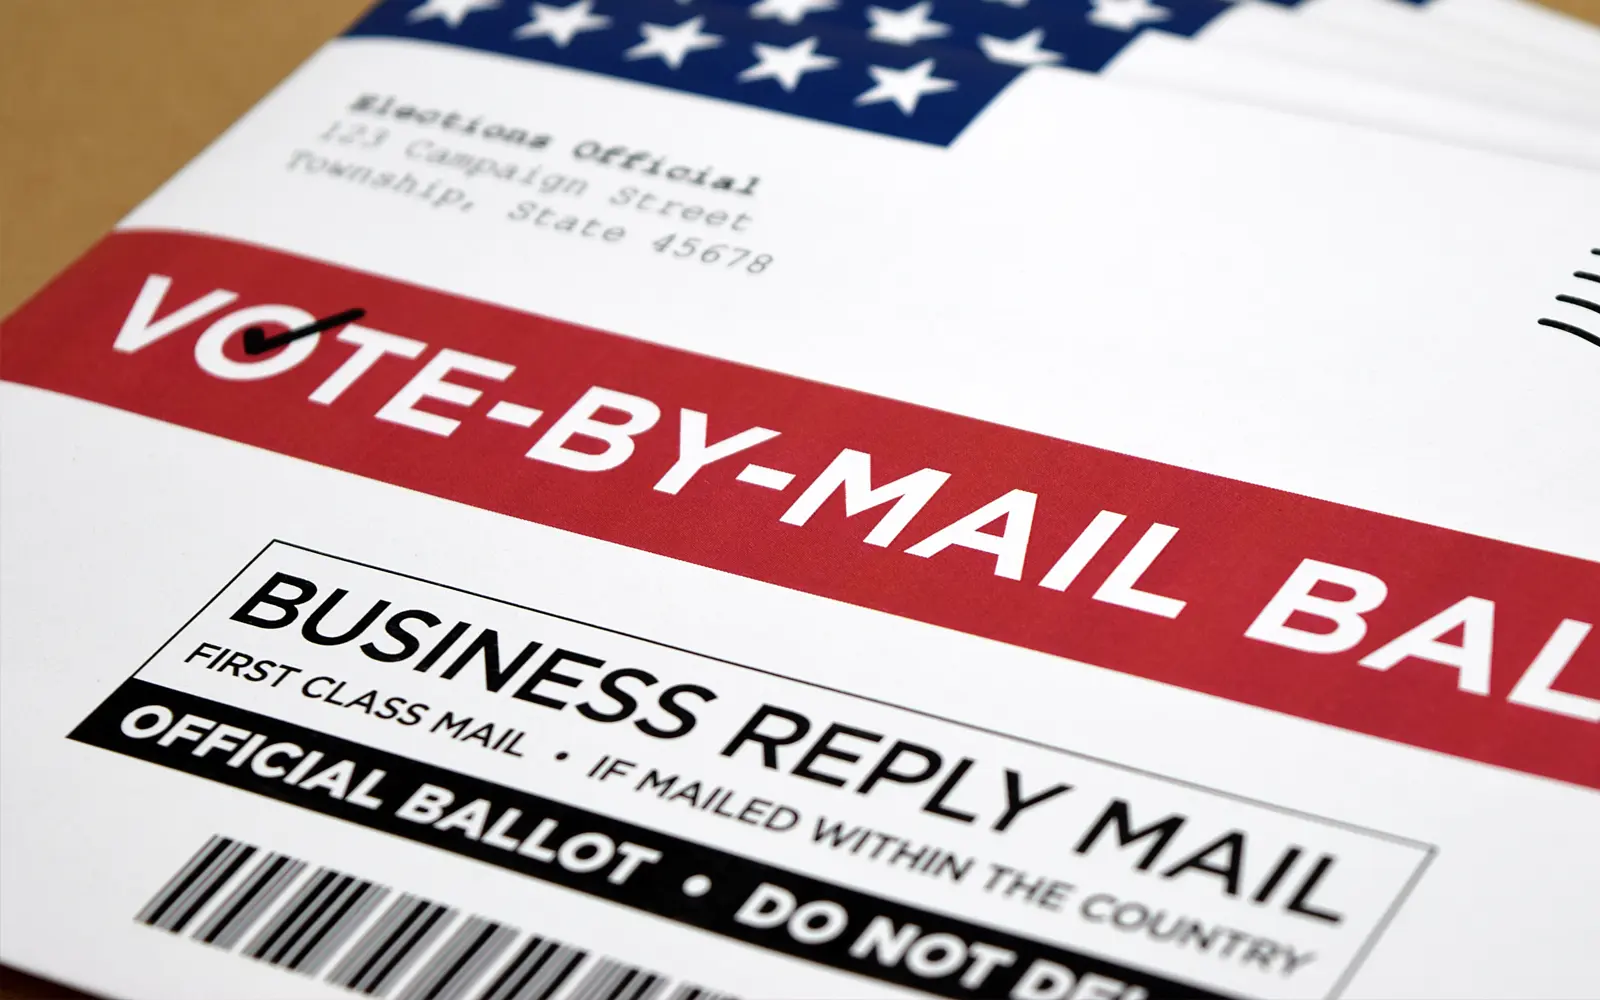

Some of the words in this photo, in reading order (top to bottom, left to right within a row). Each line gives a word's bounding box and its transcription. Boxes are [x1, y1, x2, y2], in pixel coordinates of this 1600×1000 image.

[286, 148, 478, 213] Township,
[507, 200, 627, 244] State
[651, 233, 774, 274] 45678
[318, 120, 390, 148] 123
[405, 138, 589, 196] Campaign
[610, 185, 755, 234] Street
[347, 93, 551, 149] Elections
[572, 139, 761, 196] Official
[112, 273, 1187, 619] VOTE-BY-MAIL
[120, 704, 386, 811] OFFICIAL
[394, 782, 660, 887] BALLOT
[735, 882, 850, 946] DO
[848, 916, 1018, 991] NOT
[183, 642, 302, 689] FIRST
[300, 677, 428, 727] CLASS
[430, 711, 526, 758] MAIL
[587, 755, 635, 781] IF
[636, 770, 800, 834] MAILED
[812, 816, 977, 882] WITHIN
[986, 863, 1077, 912] THE
[1078, 892, 1315, 977] COUNTRY
[229, 571, 717, 740] BUSINESS
[720, 704, 1072, 832] REPLY
[1074, 798, 1344, 925] MAIL
